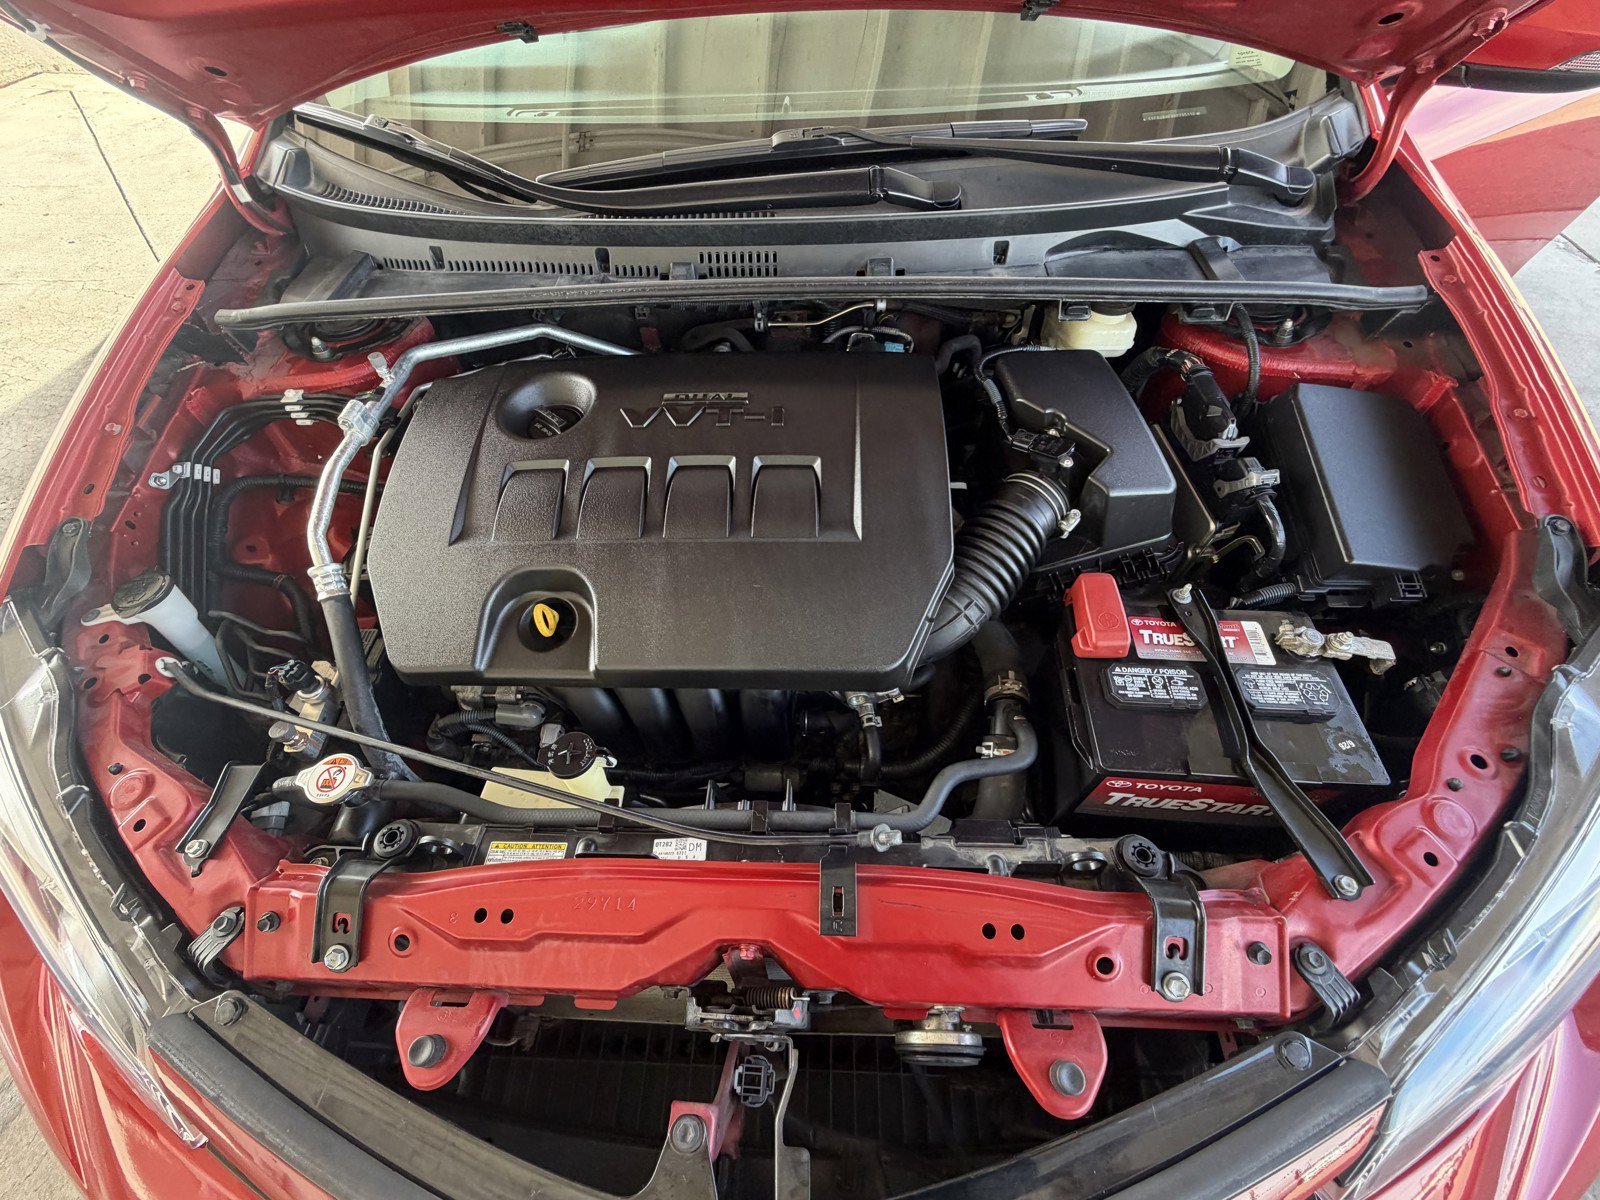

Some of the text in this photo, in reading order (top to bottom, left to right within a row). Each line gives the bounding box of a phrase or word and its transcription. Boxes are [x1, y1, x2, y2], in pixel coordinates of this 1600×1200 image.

[1143, 619, 1177, 628] TOYOTA
[1122, 666, 1152, 674] DANGER
[1135, 782, 1203, 793] TOYOTA
[688, 842, 703, 852] DM
